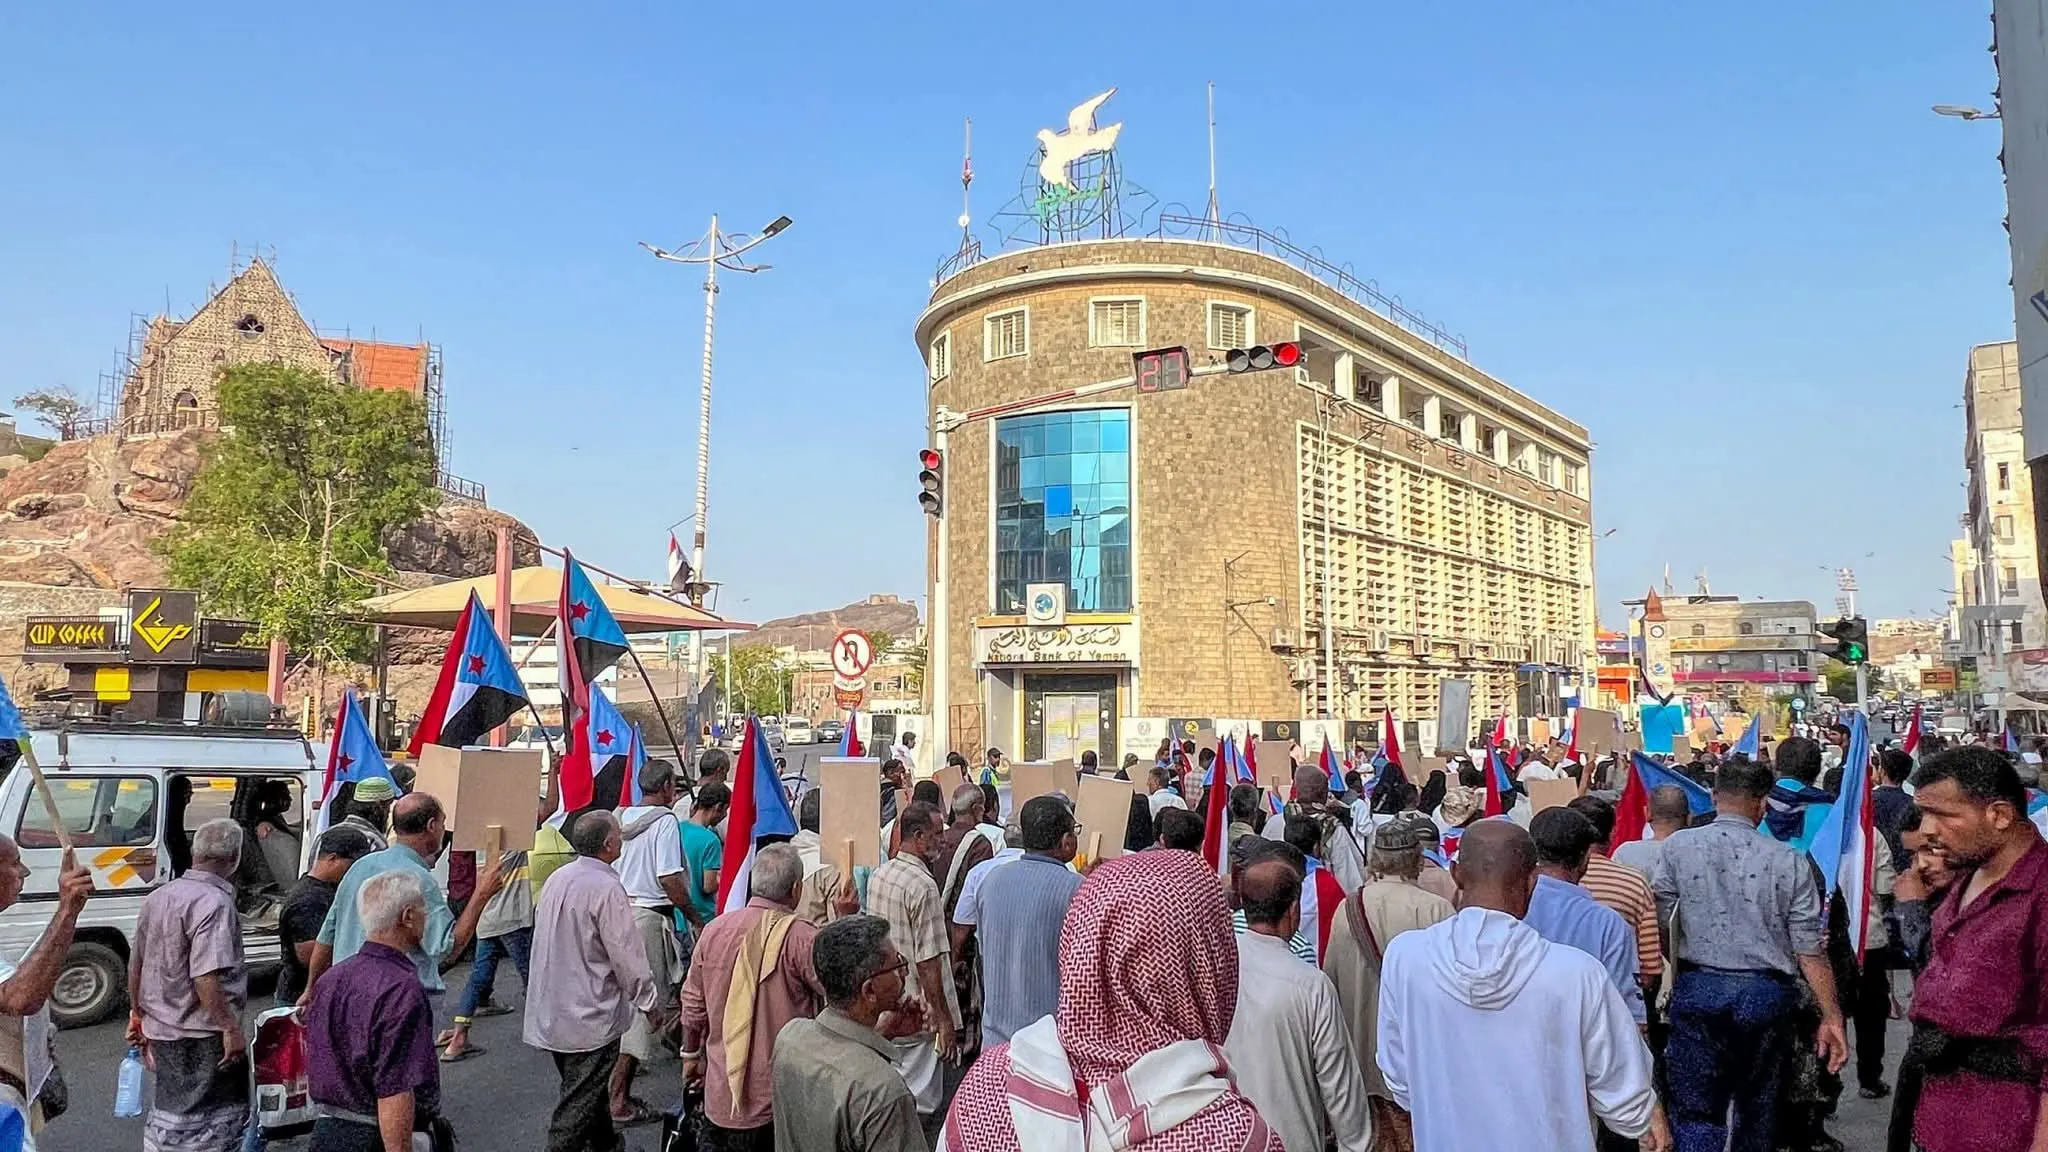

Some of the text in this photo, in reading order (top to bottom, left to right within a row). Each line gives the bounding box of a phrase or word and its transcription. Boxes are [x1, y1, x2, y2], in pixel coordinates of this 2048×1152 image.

[29, 624, 105, 645] CUP COFFEE
[1074, 626, 1121, 646] البنك
[1034, 651, 1062, 661] Bank
[1089, 650, 1127, 661] Yemen
